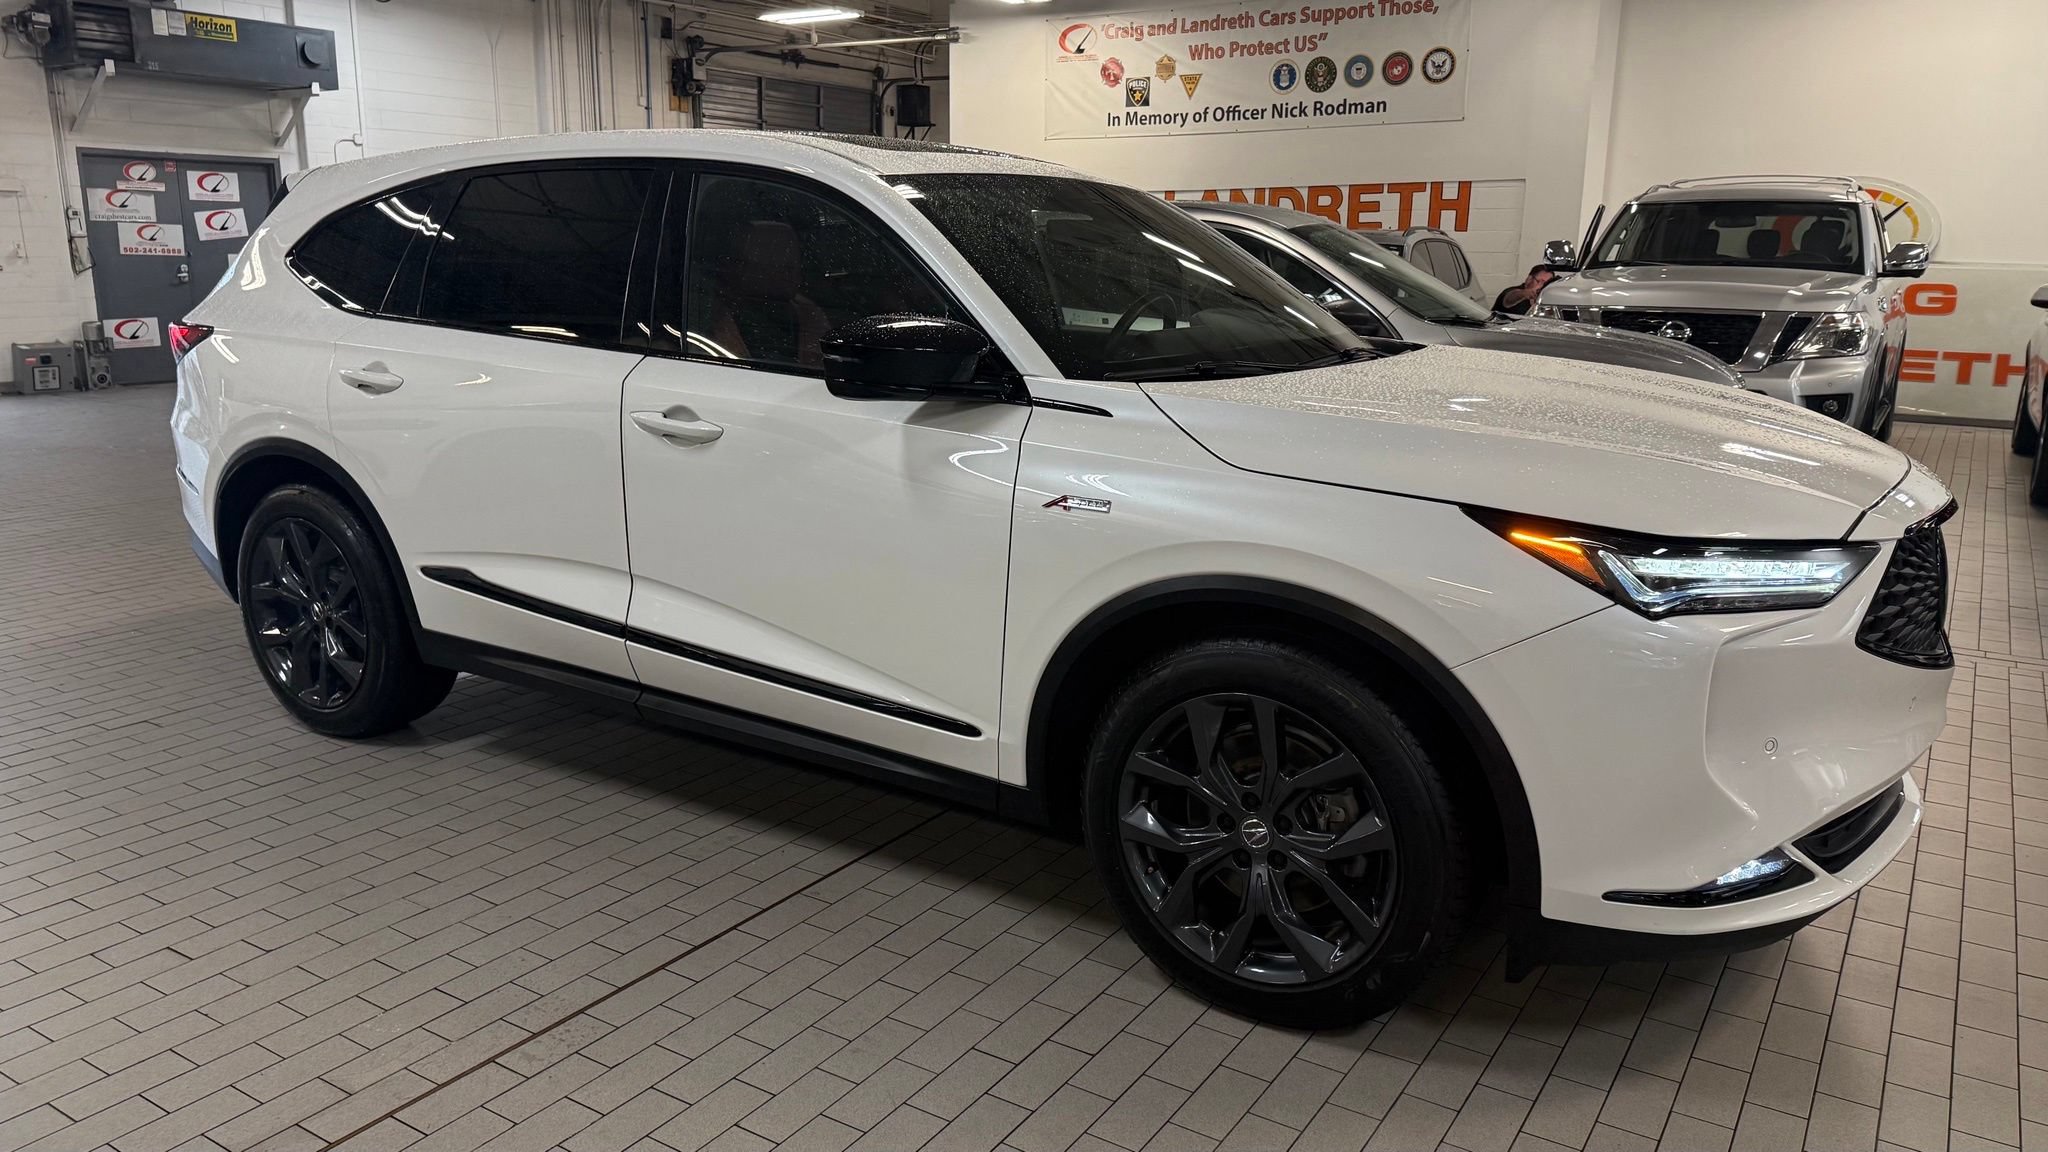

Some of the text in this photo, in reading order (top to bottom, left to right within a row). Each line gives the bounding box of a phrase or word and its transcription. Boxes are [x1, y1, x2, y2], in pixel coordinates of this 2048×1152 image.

[190, 16, 232, 33] Horizon
[1147, 18, 1178, 37] and
[1181, 11, 1255, 34] Landreth
[1259, 10, 1296, 27] Cars
[1300, 5, 1374, 26] Support
[1378, 0, 1439, 17] Those,
[1188, 43, 1226, 61] Who
[1229, 39, 1290, 58] Protect
[1129, 80, 1148, 90] POLICE
[1107, 98, 1387, 128] In Memory of Officer Nick Rodman
